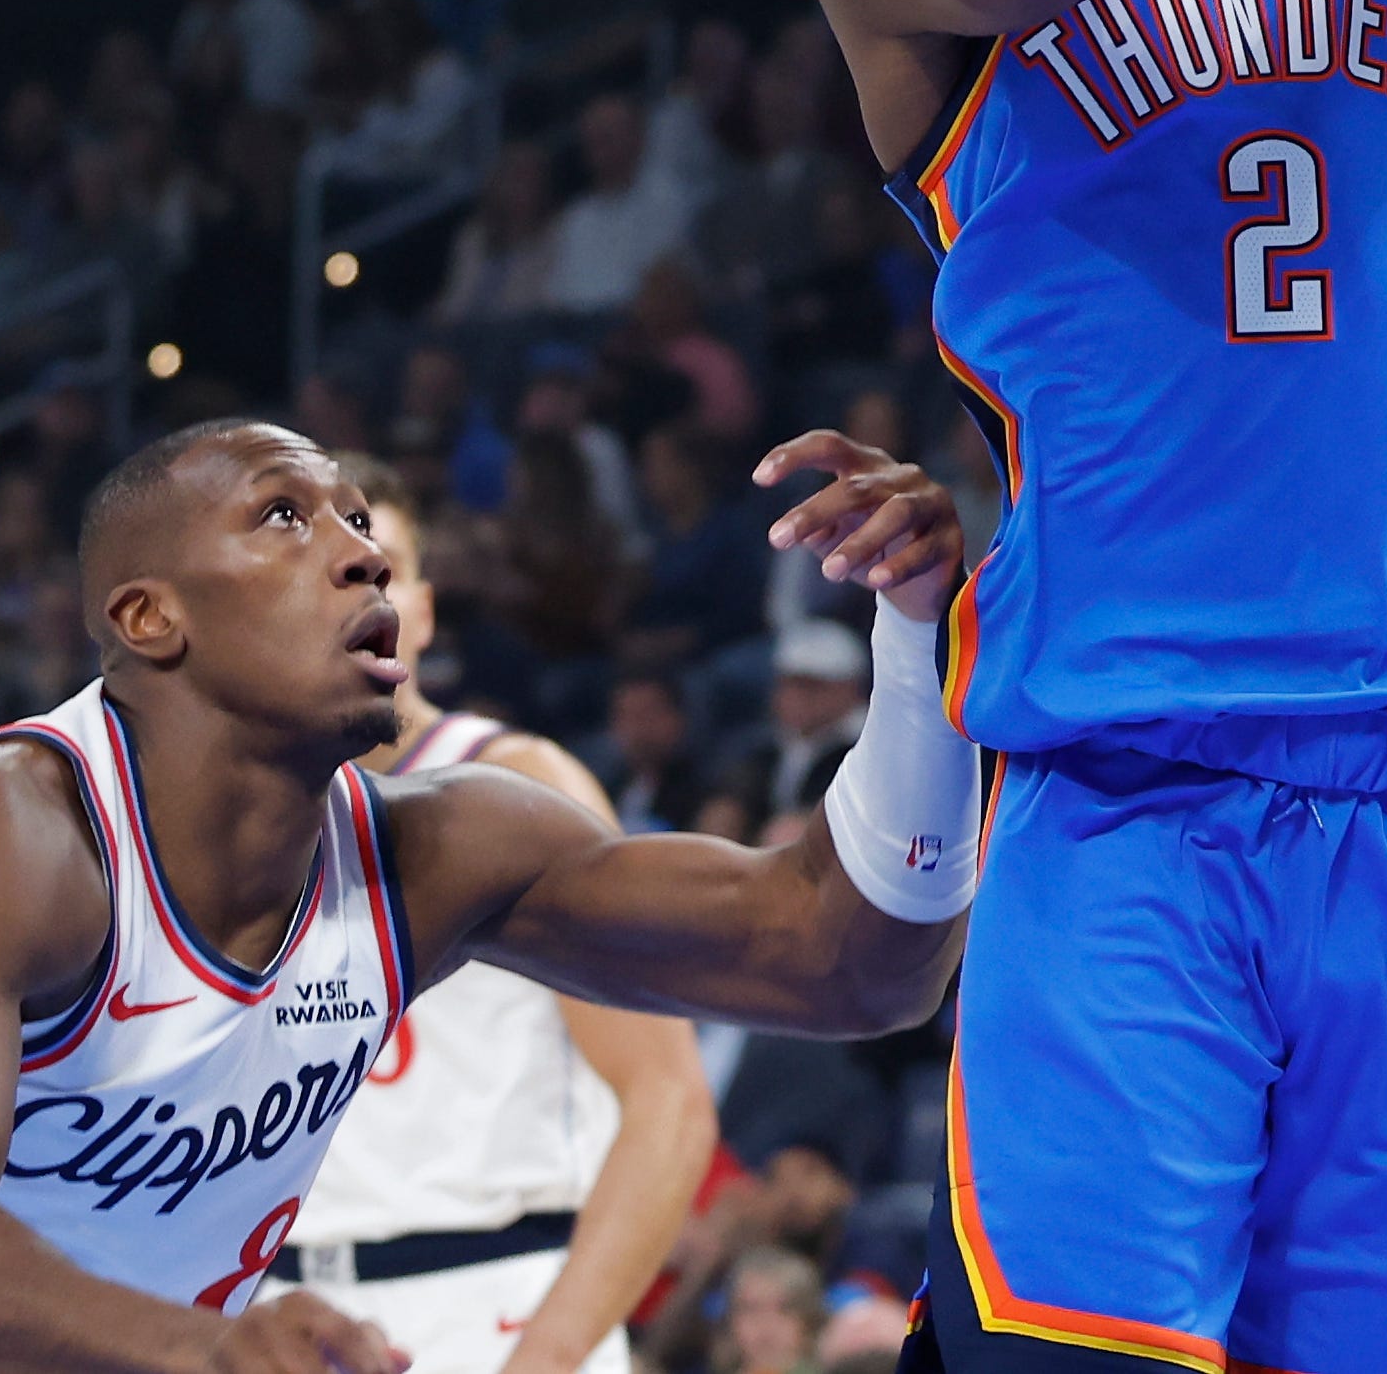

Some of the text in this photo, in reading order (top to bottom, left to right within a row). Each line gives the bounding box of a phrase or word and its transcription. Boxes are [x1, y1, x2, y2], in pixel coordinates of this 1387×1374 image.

[1220, 129, 1333, 343] 2
[276, 999, 377, 1026] RWANDA
[295, 979, 349, 1002] VISIT
[3, 1037, 369, 1216] Clippers
